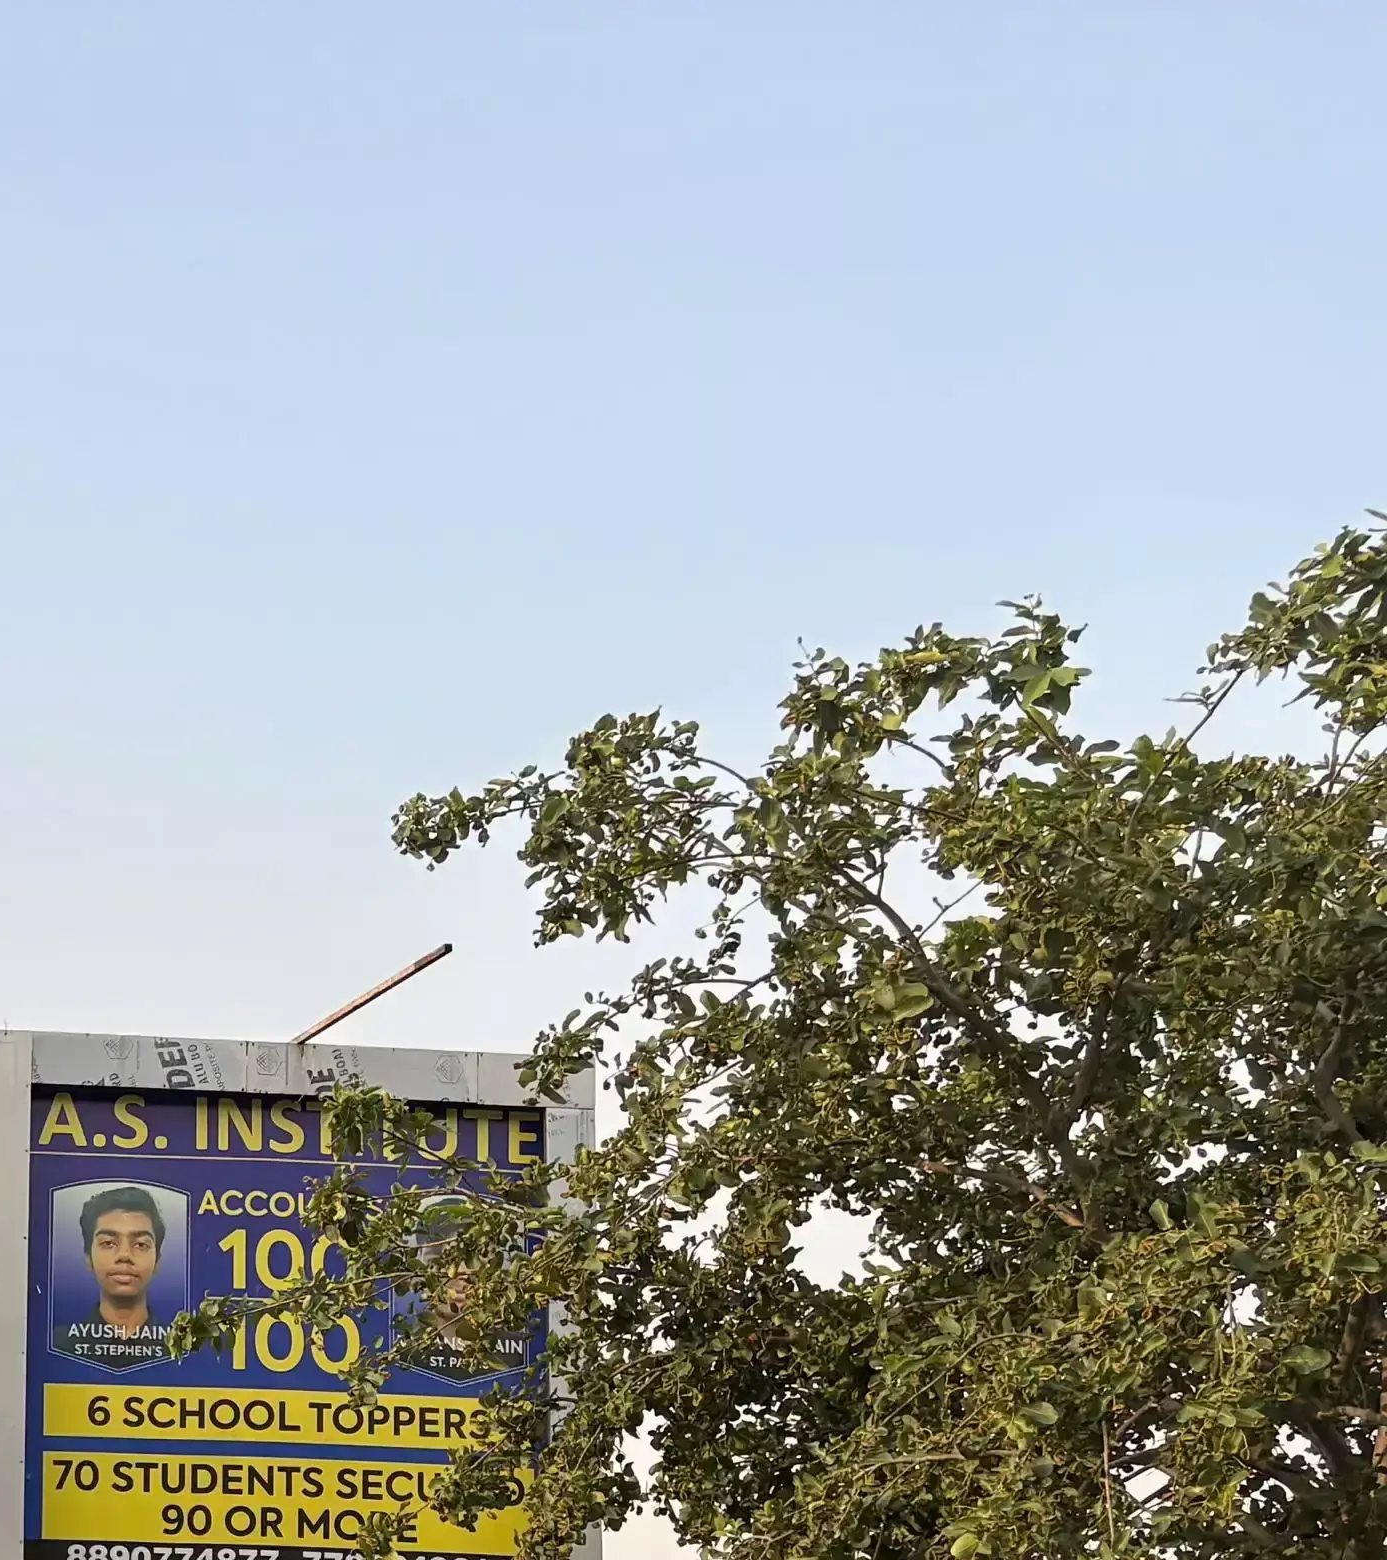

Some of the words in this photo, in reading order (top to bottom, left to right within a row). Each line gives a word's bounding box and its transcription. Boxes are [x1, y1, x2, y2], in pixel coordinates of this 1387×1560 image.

[38, 1092, 169, 1150] A.S.
[68, 1322, 126, 1339] AYUSH
[130, 1324, 171, 1341] JAIN
[74, 1344, 91, 1357] ST.
[95, 1345, 164, 1359] STEPHEN'S
[429, 1356, 446, 1368] ST.
[88, 1396, 110, 1427] 6
[123, 1397, 301, 1433] SCHOOL
[309, 1402, 493, 1440] TOPPERS
[52, 1459, 99, 1492] 70
[112, 1461, 324, 1498] STUDENTS
[162, 1504, 213, 1537] 90
[225, 1507, 284, 1538] OR
